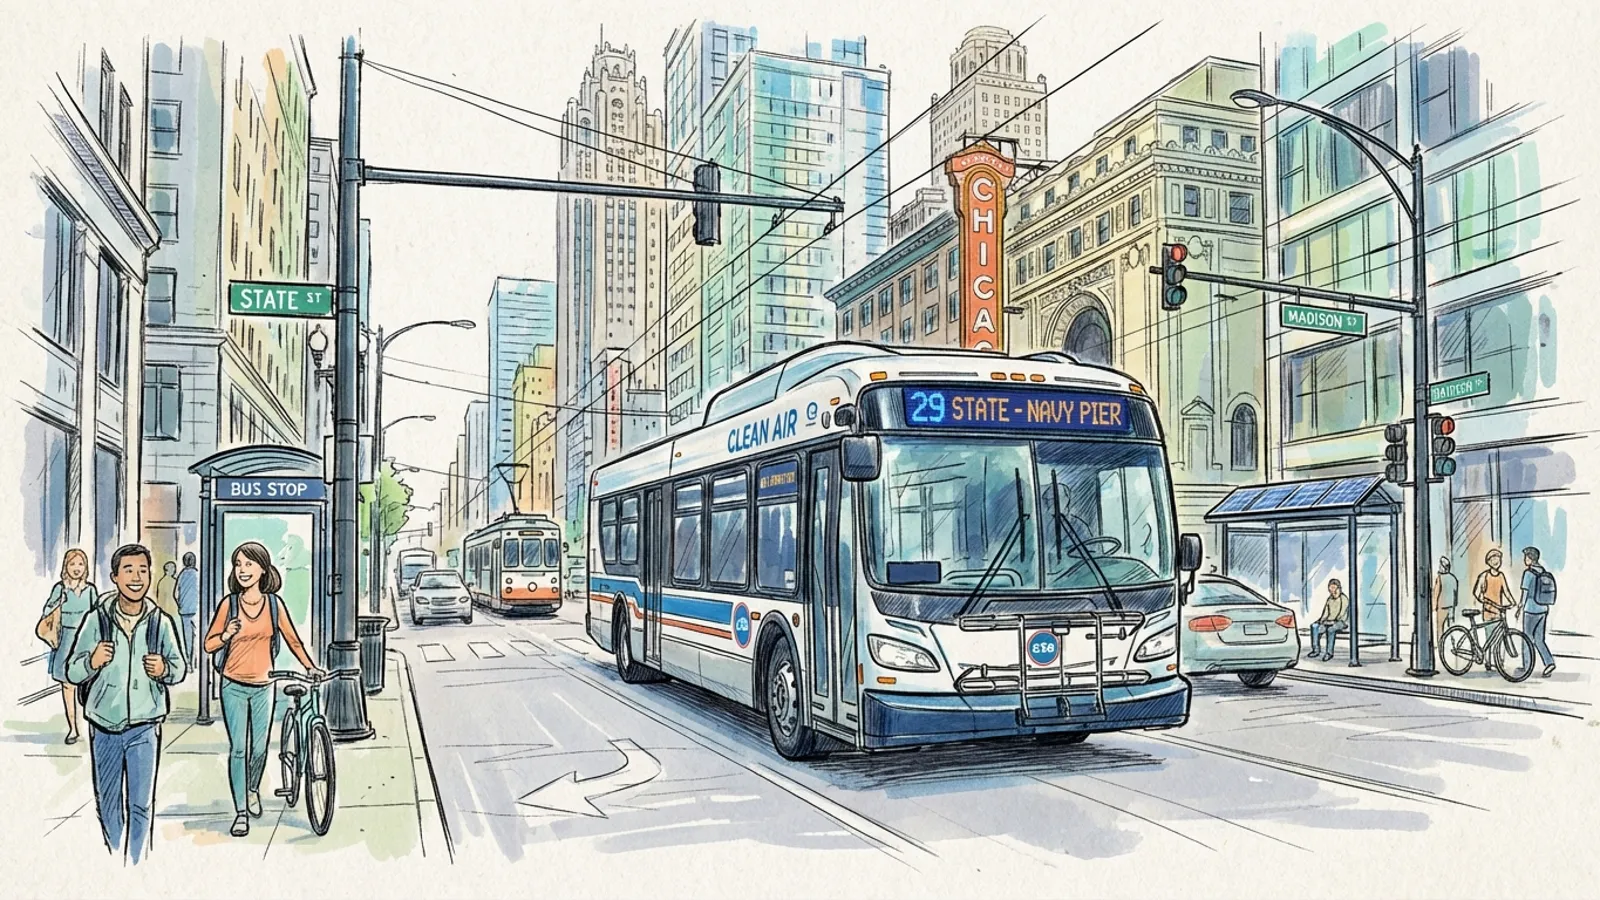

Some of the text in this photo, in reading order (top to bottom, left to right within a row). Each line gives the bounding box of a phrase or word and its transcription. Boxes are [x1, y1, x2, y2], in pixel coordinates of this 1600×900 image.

[240, 288, 322, 310] STATE ST
[1288, 310, 1343, 328] MADISON
[910, 391, 946, 423] 29
[951, 396, 1010, 422] STATE
[1027, 399, 1075, 424] NAVY
[1079, 401, 1122, 426] PIER
[727, 418, 770, 453] CLEAN
[771, 408, 798, 442] AIR
[231, 482, 308, 497] BUS STOP
